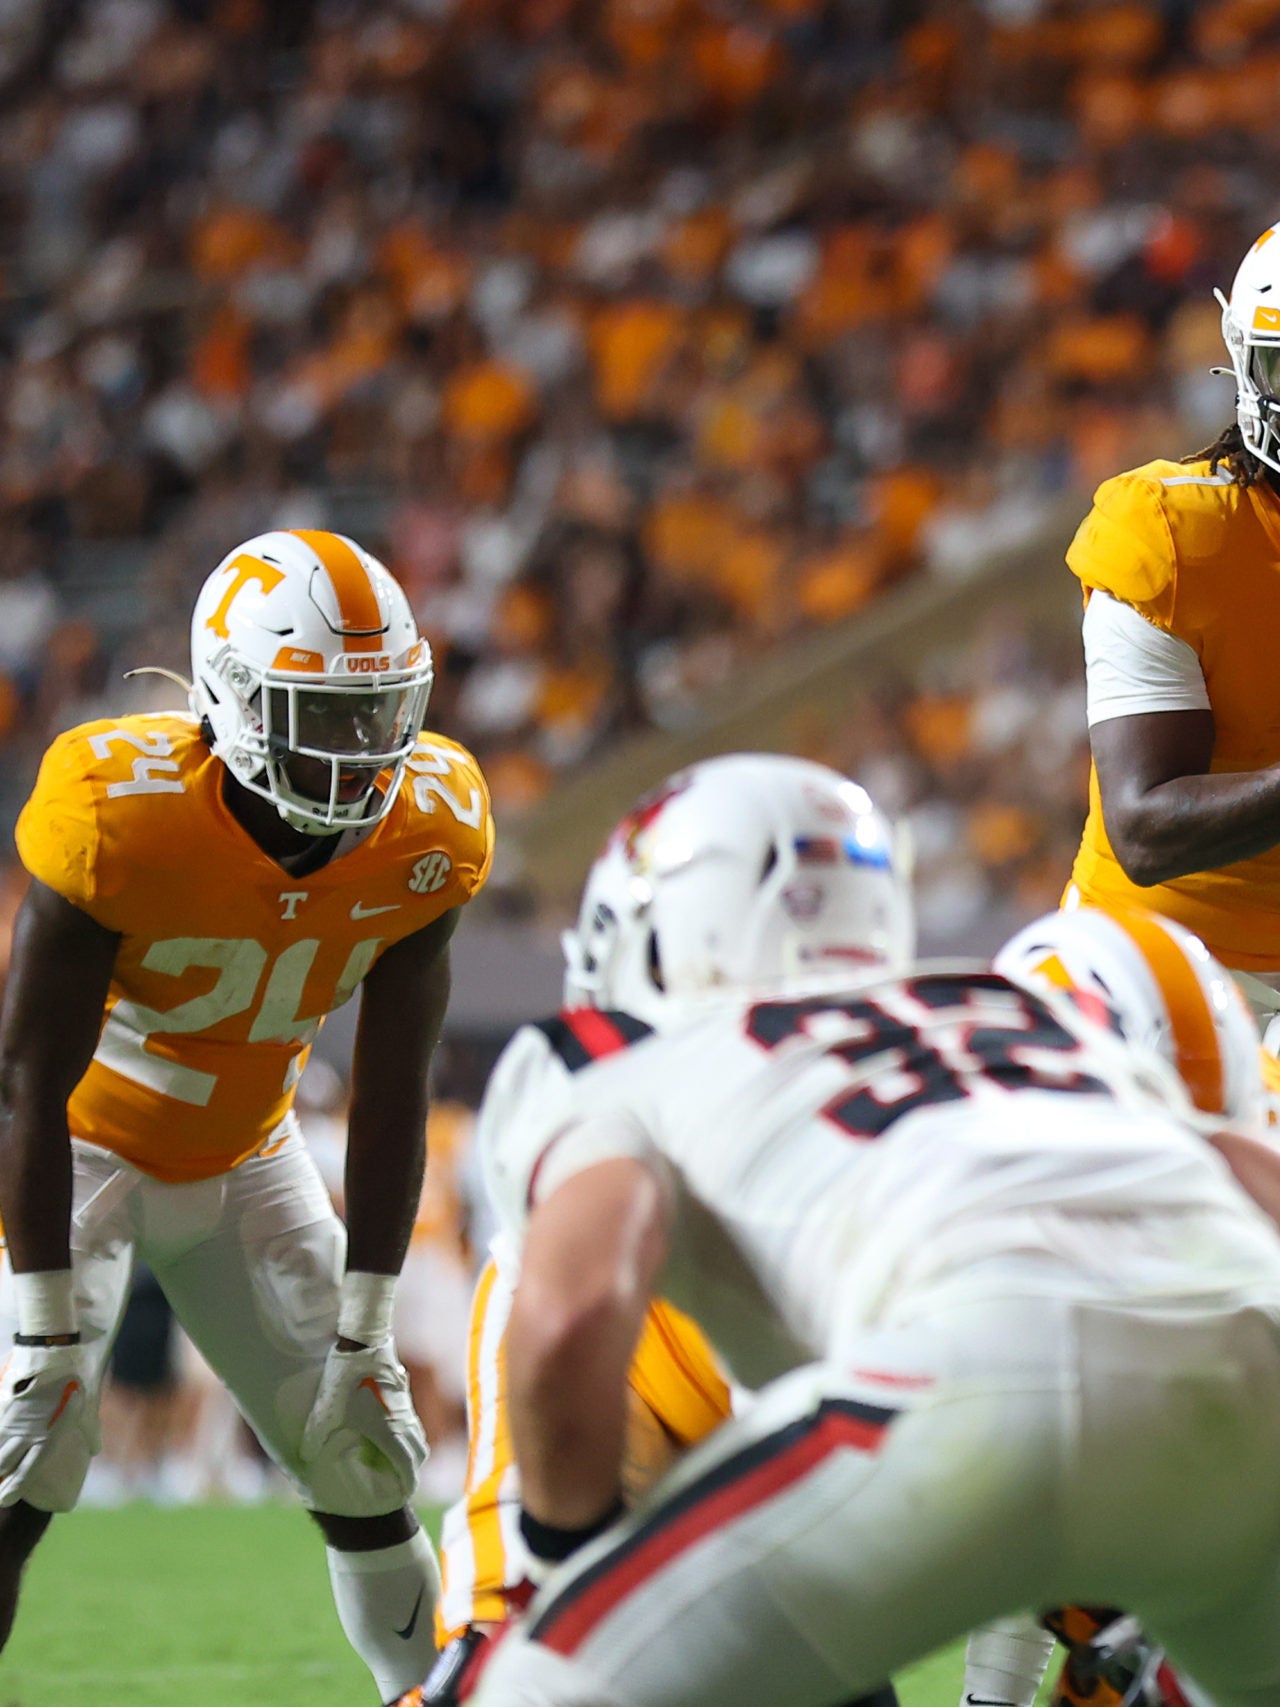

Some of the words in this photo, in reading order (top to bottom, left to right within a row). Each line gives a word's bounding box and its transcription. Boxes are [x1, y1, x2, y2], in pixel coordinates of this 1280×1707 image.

[205, 553, 287, 640] T
[346, 656, 390, 673] VOLS
[87, 729, 186, 799] 24
[404, 743, 482, 831] 24
[279, 891, 309, 920] T
[408, 852, 452, 894] SEC
[92, 937, 384, 1107] 24
[744, 972, 1118, 1142] 32
